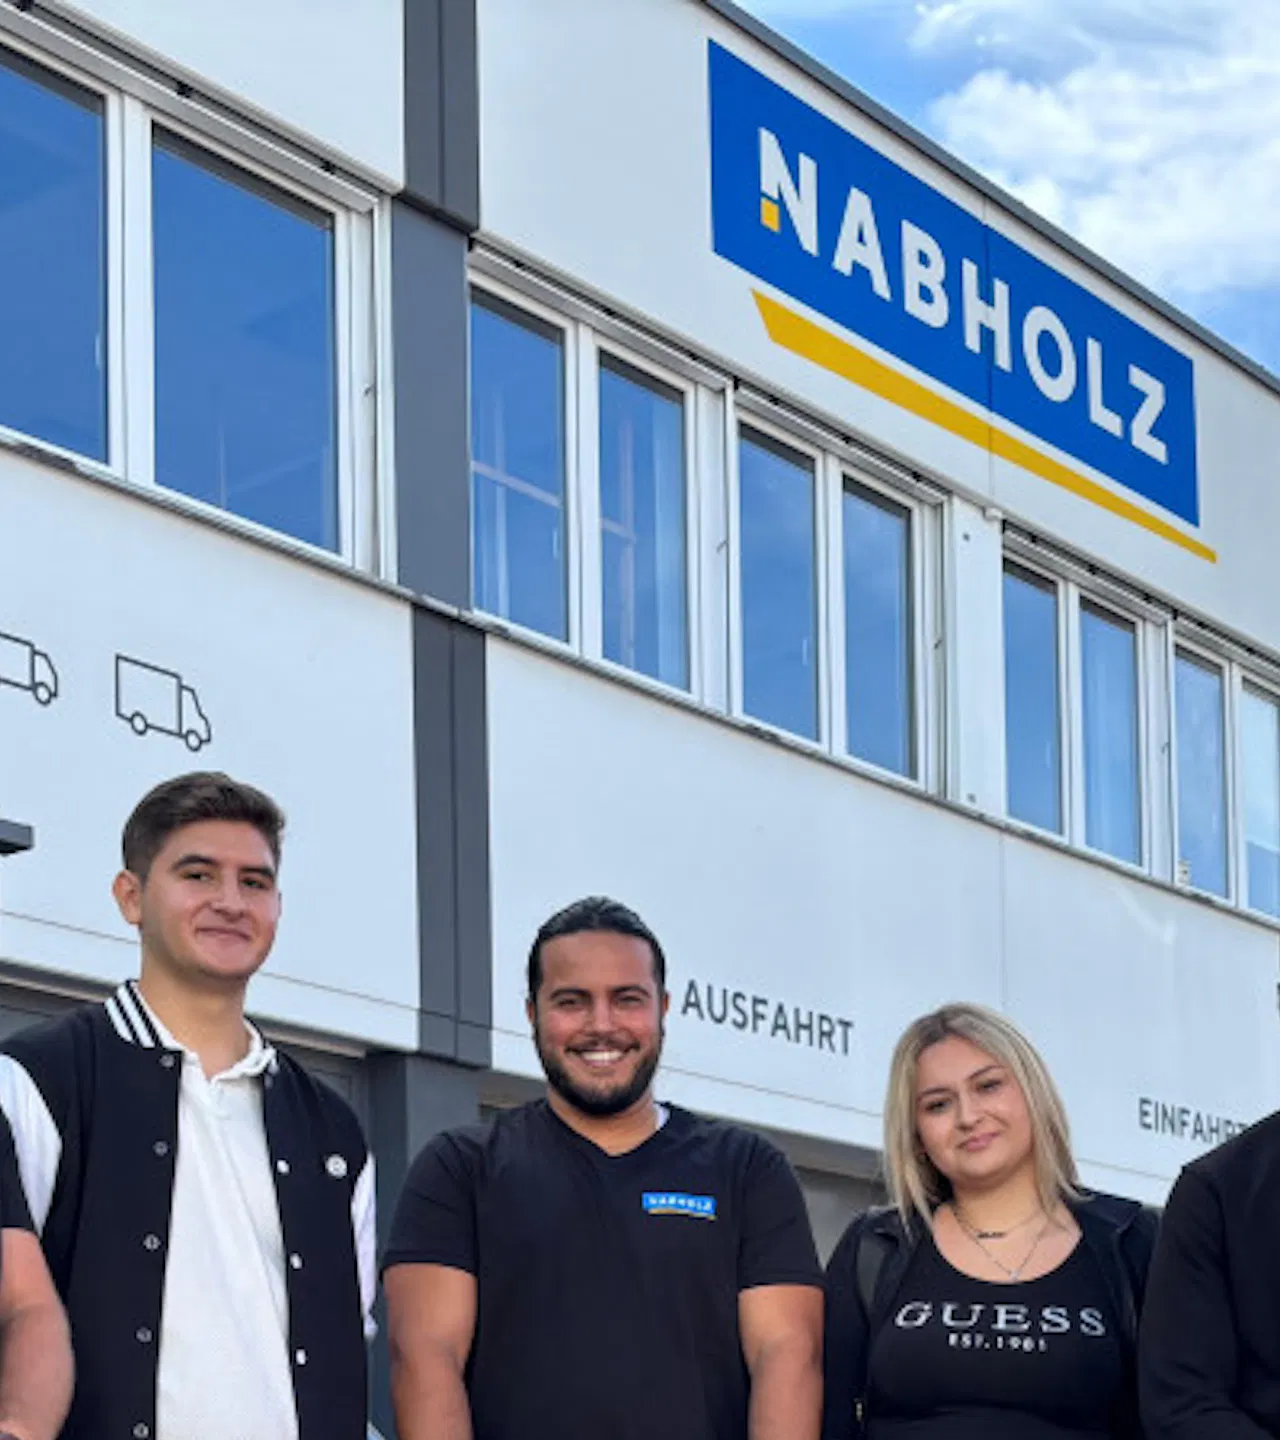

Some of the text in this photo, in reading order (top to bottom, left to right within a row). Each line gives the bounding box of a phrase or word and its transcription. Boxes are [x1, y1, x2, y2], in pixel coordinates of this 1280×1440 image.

[759, 126, 1168, 466] NABHOLZ
[680, 979, 854, 1056] AUSFAHRT
[1138, 1097, 1248, 1144] EINFAHR
[894, 1300, 1107, 1337] GUESS
